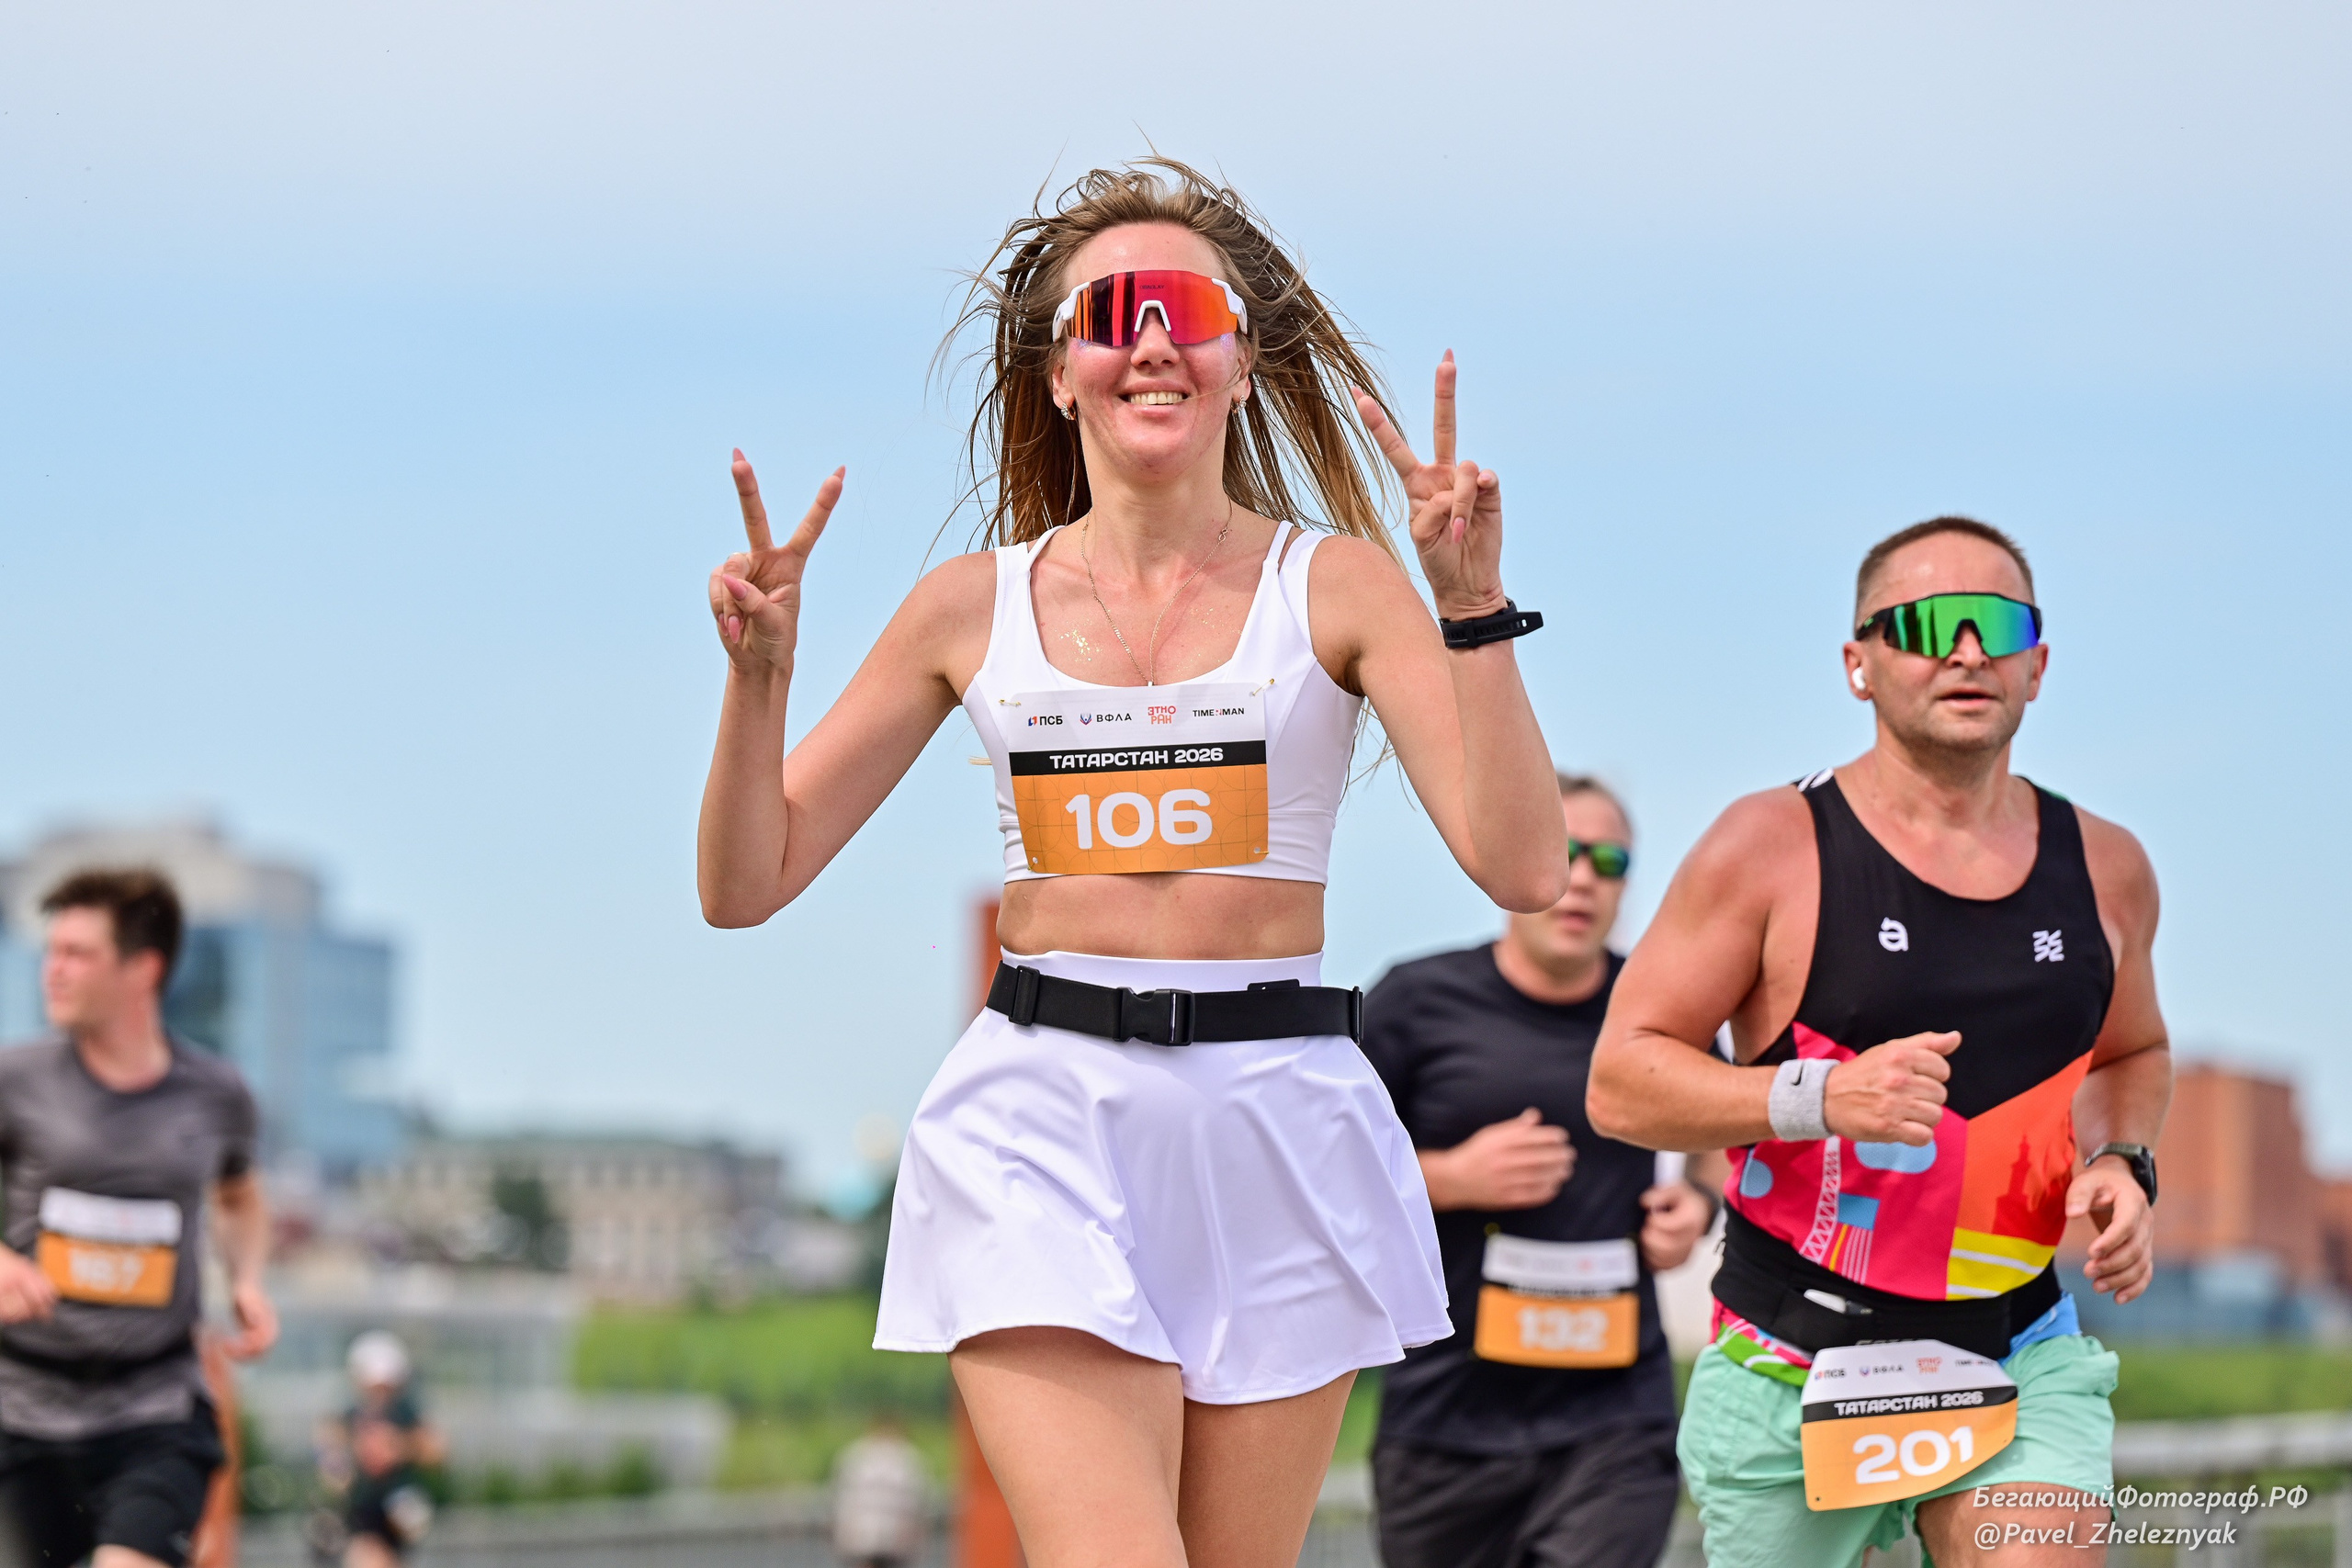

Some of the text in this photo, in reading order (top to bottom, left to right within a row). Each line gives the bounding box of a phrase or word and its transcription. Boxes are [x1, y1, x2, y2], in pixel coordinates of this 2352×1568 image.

[1039, 716, 1063, 726] ПСБ
[1096, 713, 1132, 722] ВФЛА
[1148, 705, 1176, 716] ЭТНО
[1151, 715, 1172, 725] РАН
[1049, 748, 1224, 769] ТАТАРСТАН 2026
[1065, 788, 1213, 849] 106
[1518, 1305, 1608, 1352] 132
[1834, 1391, 1984, 1416] ТАТАРСТАН 2026
[1852, 1426, 1973, 1484] 201
